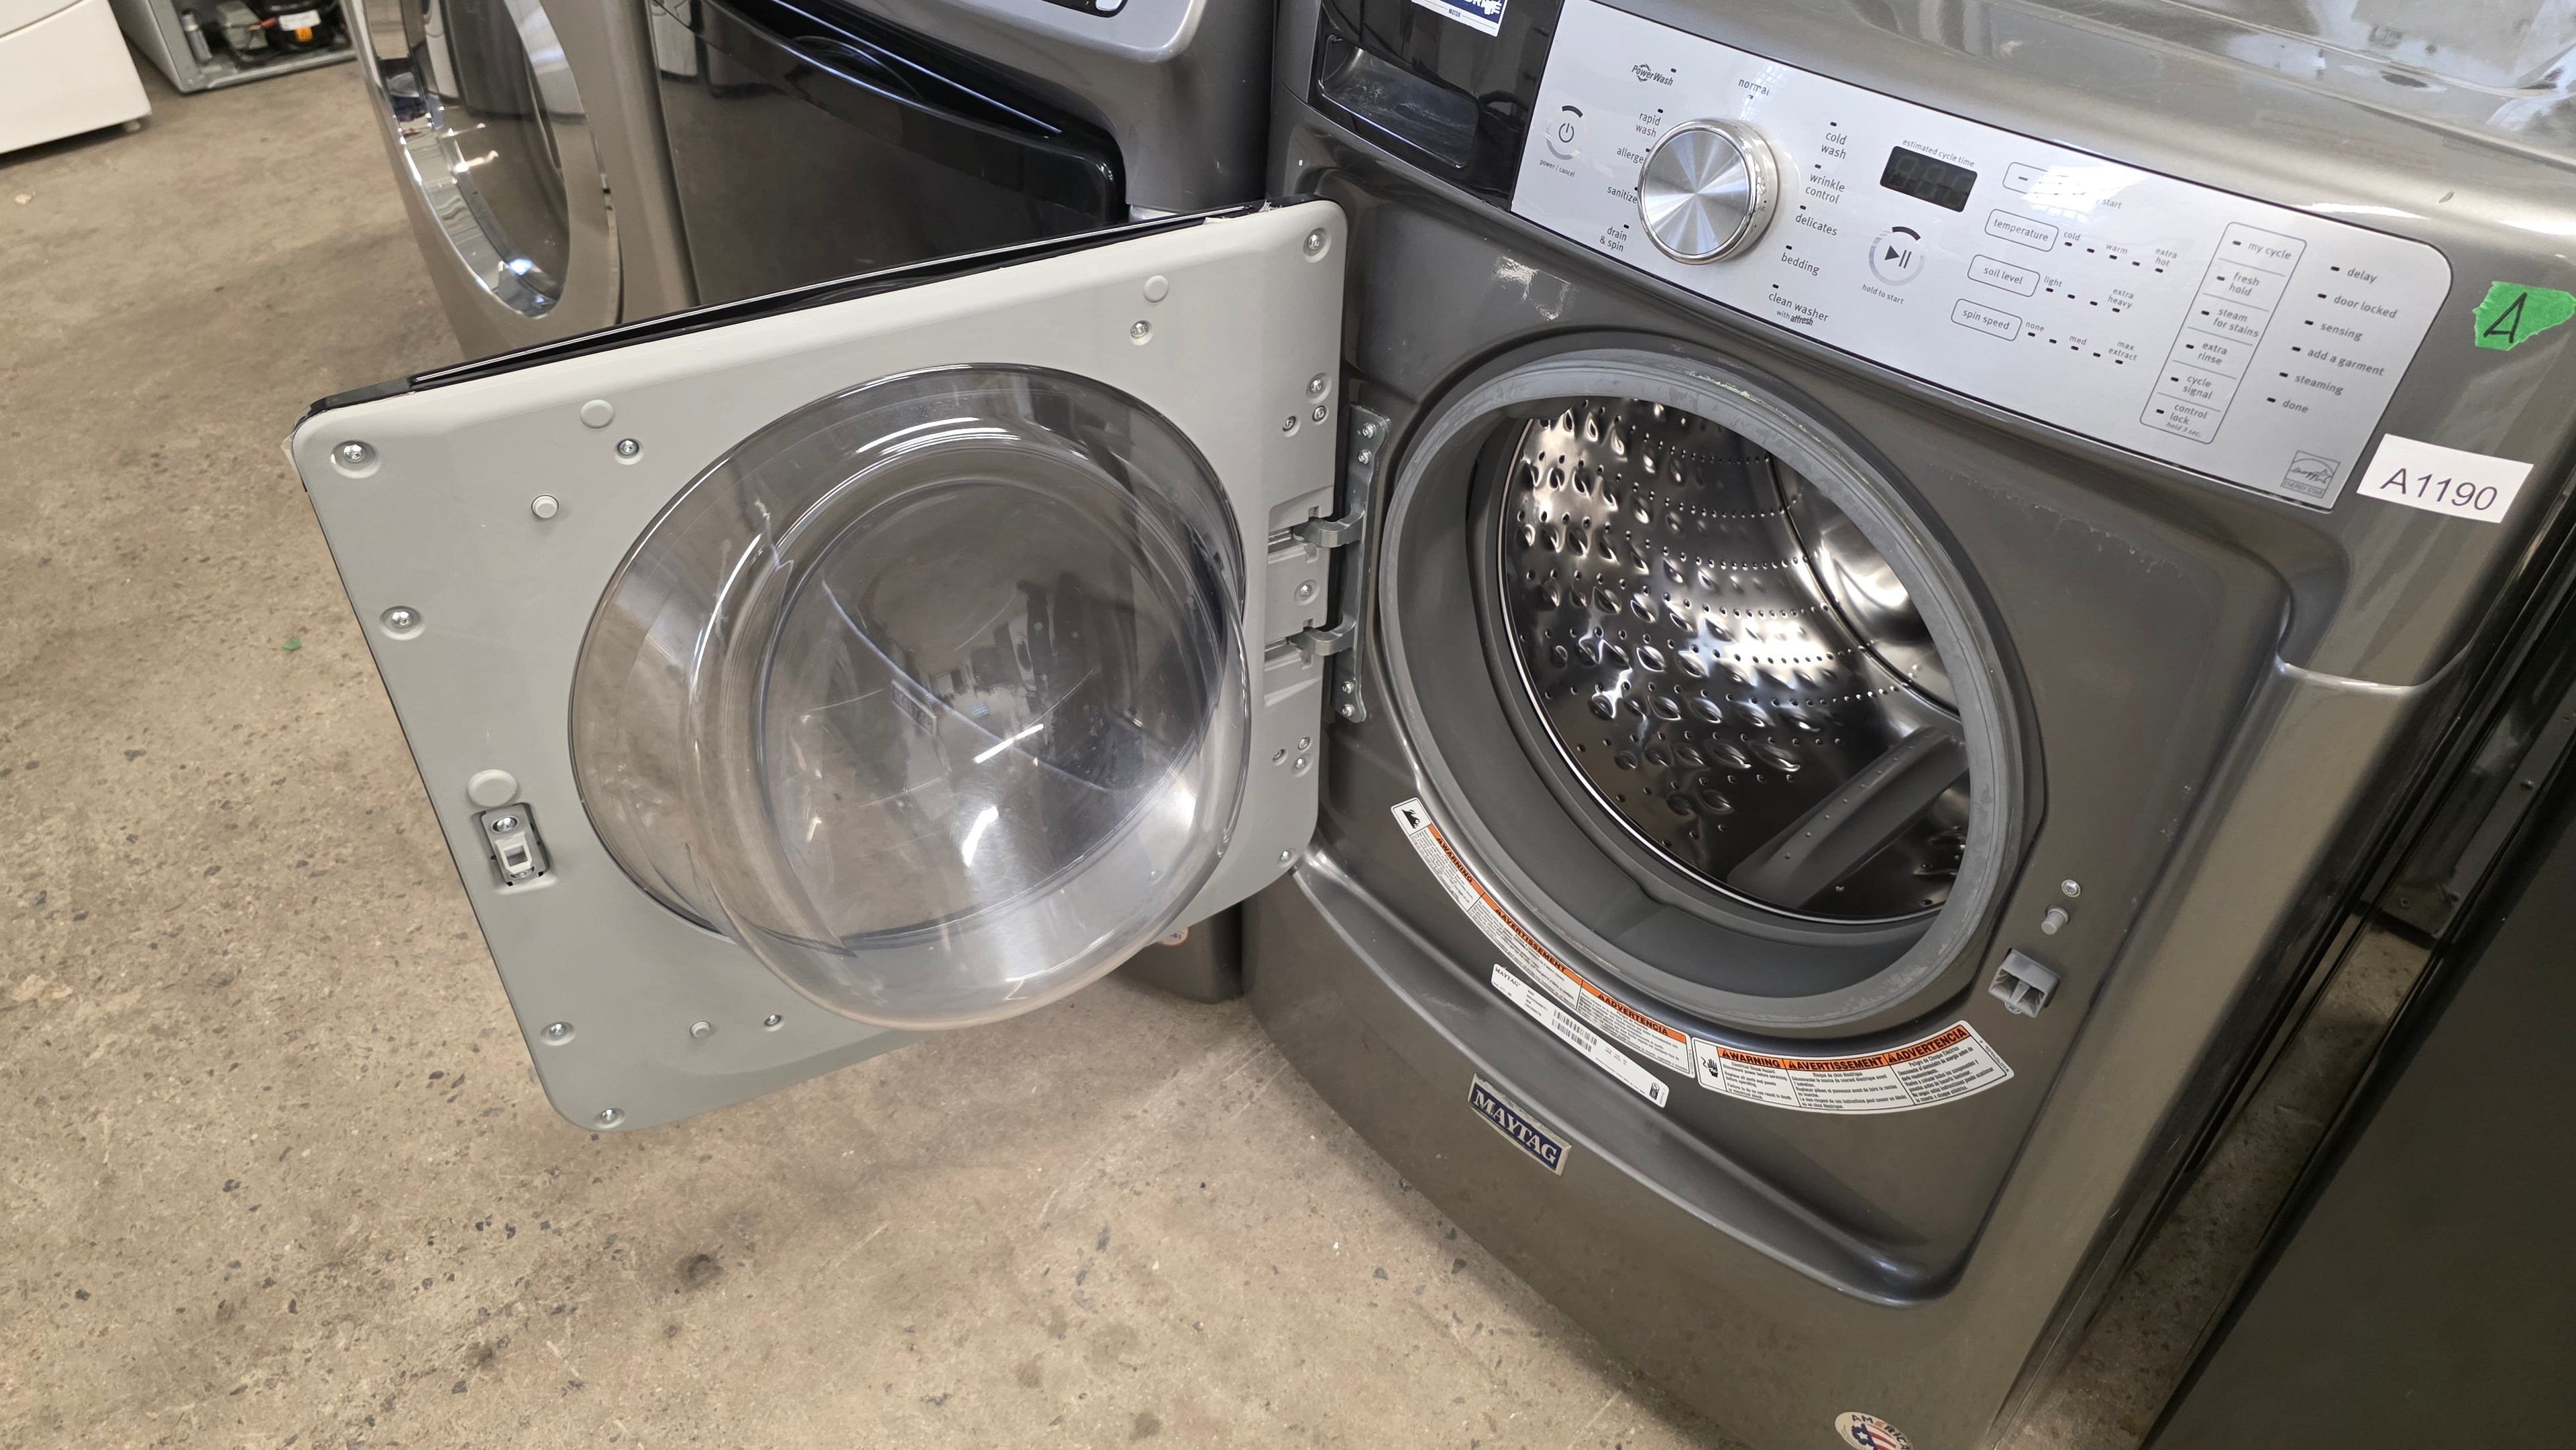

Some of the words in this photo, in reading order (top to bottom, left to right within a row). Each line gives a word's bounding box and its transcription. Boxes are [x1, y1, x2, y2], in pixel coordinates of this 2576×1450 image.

[1631, 64, 1674, 87] PowerWash
[1738, 78, 1771, 97] normal
[1639, 113, 1662, 127] rapid
[1635, 124, 1657, 138] wash
[1825, 132, 1847, 146] cold
[1617, 147, 1644, 164] allerge
[1821, 144, 1847, 160] wash
[1902, 138, 1938, 156] estimated
[1938, 150, 1957, 162] cycle
[1957, 156, 1975, 168] time
[1540, 159, 1556, 170] power
[1559, 166, 1576, 178] cancel
[1810, 174, 1845, 192] wrinkle
[1607, 186, 1638, 204] sanitize
[1805, 186, 1840, 205] control
[2101, 199, 2122, 209] start
[1795, 213, 1838, 236] delicates
[1993, 218, 2049, 241] temperature
[1607, 227, 1627, 241] drain
[2063, 230, 2081, 241] cold
[1599, 235, 1606, 245] &
[1607, 239, 1624, 252] spin
[2105, 242, 2129, 255] warm
[2247, 241, 2264, 254] my
[2264, 247, 2292, 261] cycle
[2155, 247, 2178, 260] extra
[1781, 252, 1821, 276] bedding
[2155, 257, 2170, 268] hot
[1984, 266, 2000, 278] soil
[2001, 272, 2024, 286] level
[2043, 275, 2063, 288] light
[2233, 272, 2261, 286] fresh
[2347, 268, 2378, 285] delay
[1862, 284, 1878, 295] hold
[1886, 294, 1904, 305] start
[2112, 288, 2135, 300] extra
[2228, 282, 2253, 297] hold
[1768, 292, 1792, 309] clean
[1794, 302, 1829, 322] washer
[2108, 295, 2133, 310] heavy
[2333, 294, 2359, 309] door
[2360, 301, 2399, 319] locked
[1776, 310, 1790, 321] with
[1790, 314, 1814, 327] affresh
[1962, 309, 1982, 322] spin
[1982, 315, 2010, 330] speed
[2217, 308, 2249, 323] steam
[2483, 291, 2528, 343] A
[2025, 321, 2045, 333] none
[2213, 317, 2229, 329] for
[2229, 322, 2260, 338] stains
[2320, 321, 2363, 342] sensing
[2069, 335, 2088, 346] med
[2116, 340, 2135, 351] max
[2202, 341, 2229, 355] extra
[2108, 346, 2138, 361] extract
[2197, 351, 2223, 366] rinse
[2307, 347, 2328, 361] add
[2329, 354, 2337, 364] a
[2337, 355, 2385, 377] garment
[2186, 373, 2212, 390] cycle
[2294, 373, 2345, 396] steaming
[2182, 384, 2214, 400] signal
[2174, 404, 2208, 419] control
[2282, 398, 2309, 414] done
[2165, 421, 2183, 431] hold
[2170, 412, 2190, 425] lock
[2379, 467, 2498, 512] A1190
[1442, 843, 1473, 883] WARNING
[1500, 912, 1566, 972] AVERTISSEMENT
[1495, 967, 1519, 987] MAYTAG
[1605, 997, 1668, 1036] ADVERTENCIA
[1896, 1028, 1968, 1061] ADVERTENCIA
[1729, 1051, 1781, 1068] WARNING
[1797, 1056, 1884, 1070] AVERTISSEMENT
[1472, 1089, 1558, 1164] MAYTAG
[1851, 1414, 1910, 1450] AMERICA
